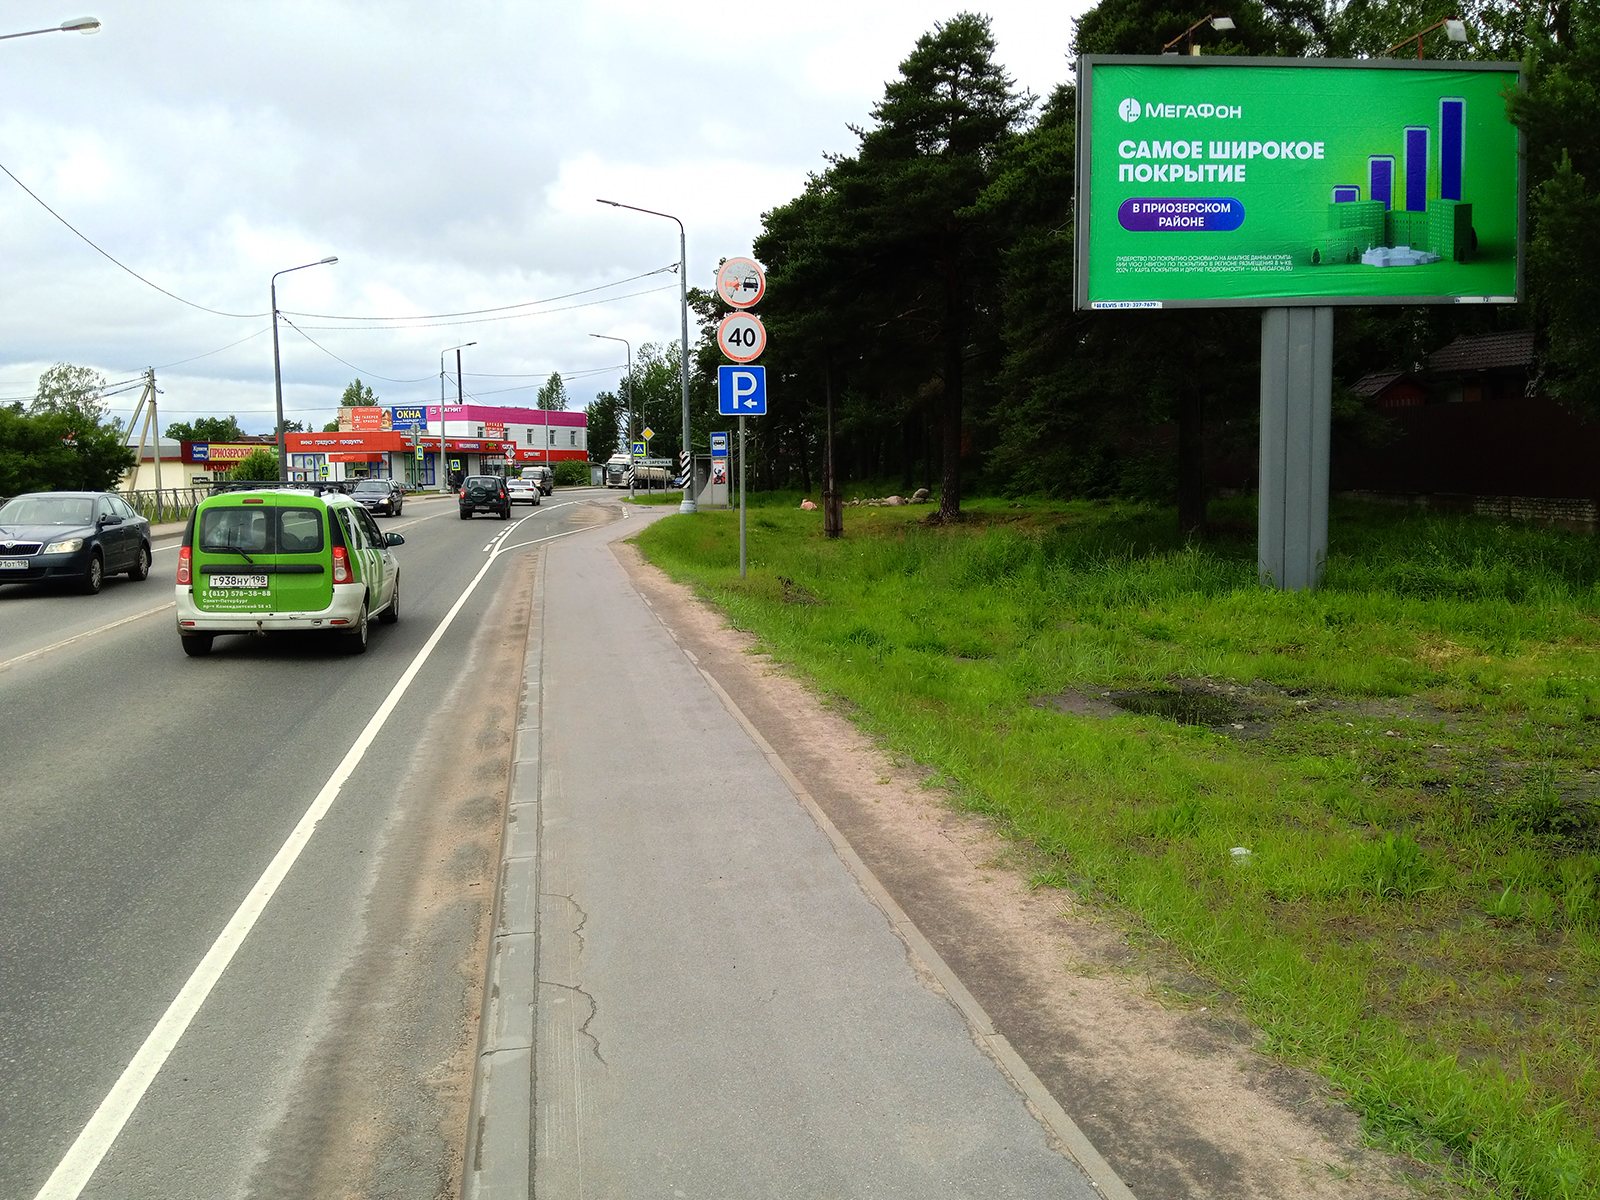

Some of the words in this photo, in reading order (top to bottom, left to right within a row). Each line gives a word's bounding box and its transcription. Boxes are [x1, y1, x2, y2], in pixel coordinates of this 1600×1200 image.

[1118, 140, 1203, 159] САМОЕ
[1209, 141, 1325, 160] ШИРОКОЕ
[1118, 164, 1246, 183] ПОКРЫТИЕ
[1133, 203, 1140, 213] В
[1143, 203, 1231, 213] ПРИОЗЕРСКОМ
[1159, 216, 1205, 227] РАЙОНЕ
[728, 328, 756, 347] 40
[396, 410, 421, 419] ОКНА
[213, 576, 249, 585] Т938НУ
[251, 575, 266, 583] 198
[208, 590, 229, 598] (812)
